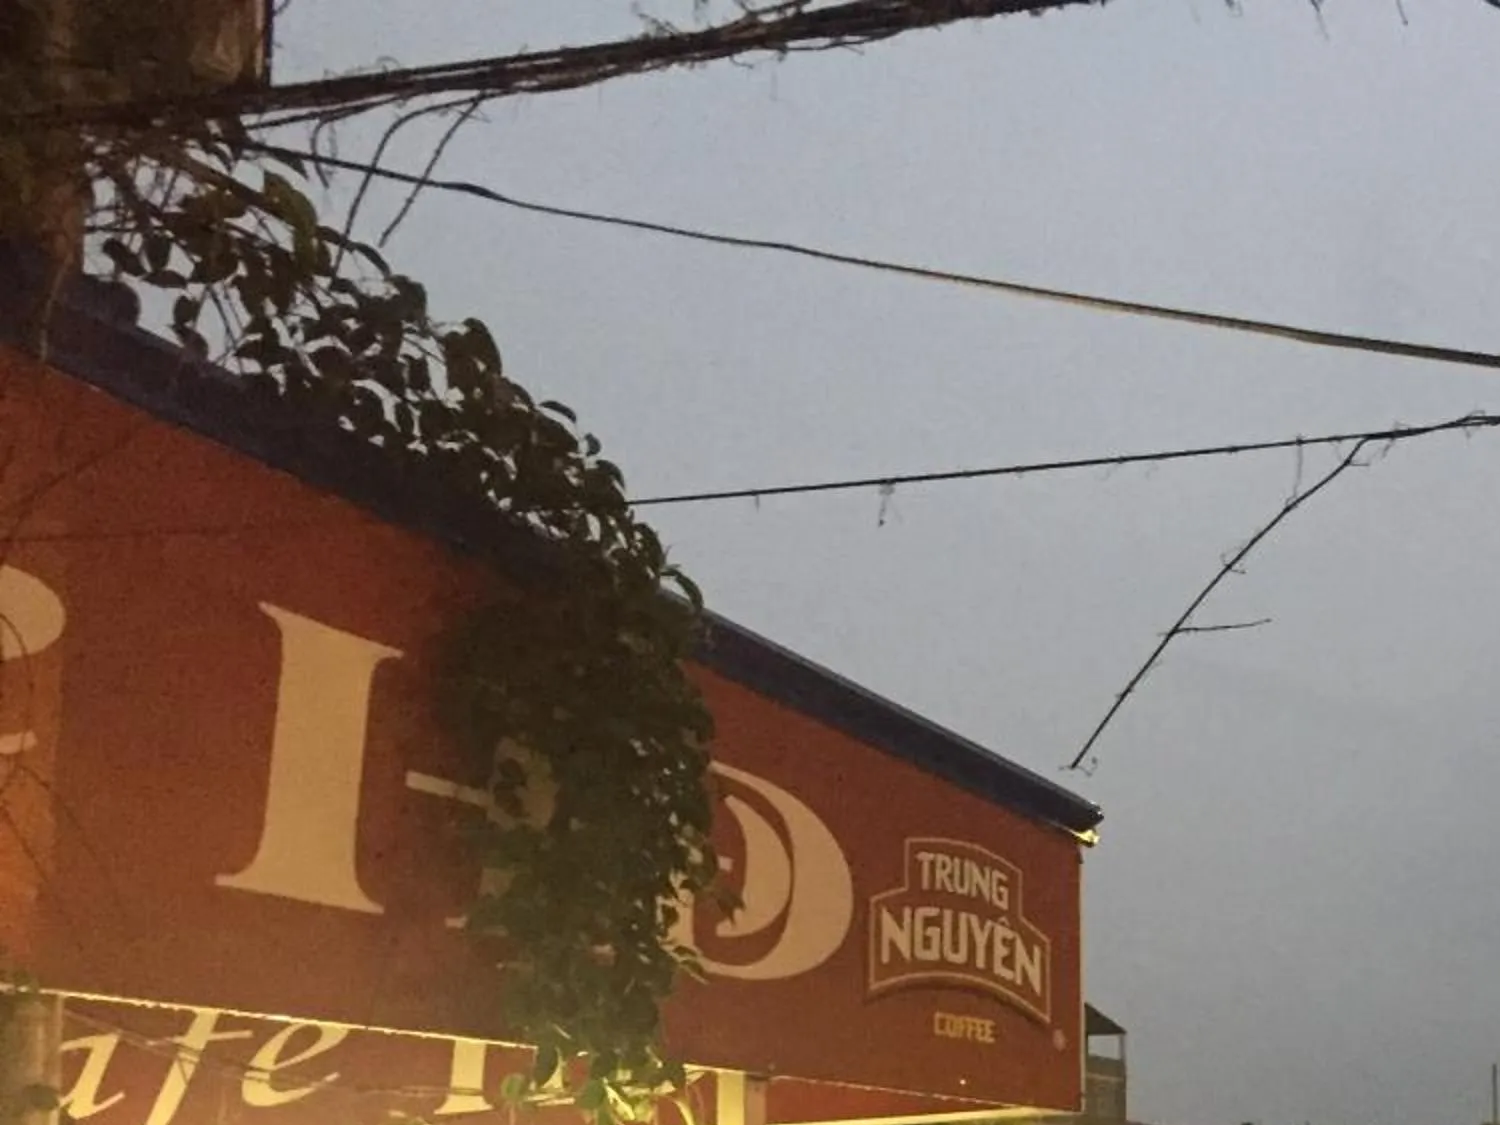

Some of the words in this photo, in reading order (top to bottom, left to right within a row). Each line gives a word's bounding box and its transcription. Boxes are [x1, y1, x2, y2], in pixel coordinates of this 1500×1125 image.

[916, 851, 1008, 911] TRUNG
[880, 905, 1042, 997] NGUYÊN
[934, 1011, 996, 1044] COFFEE
